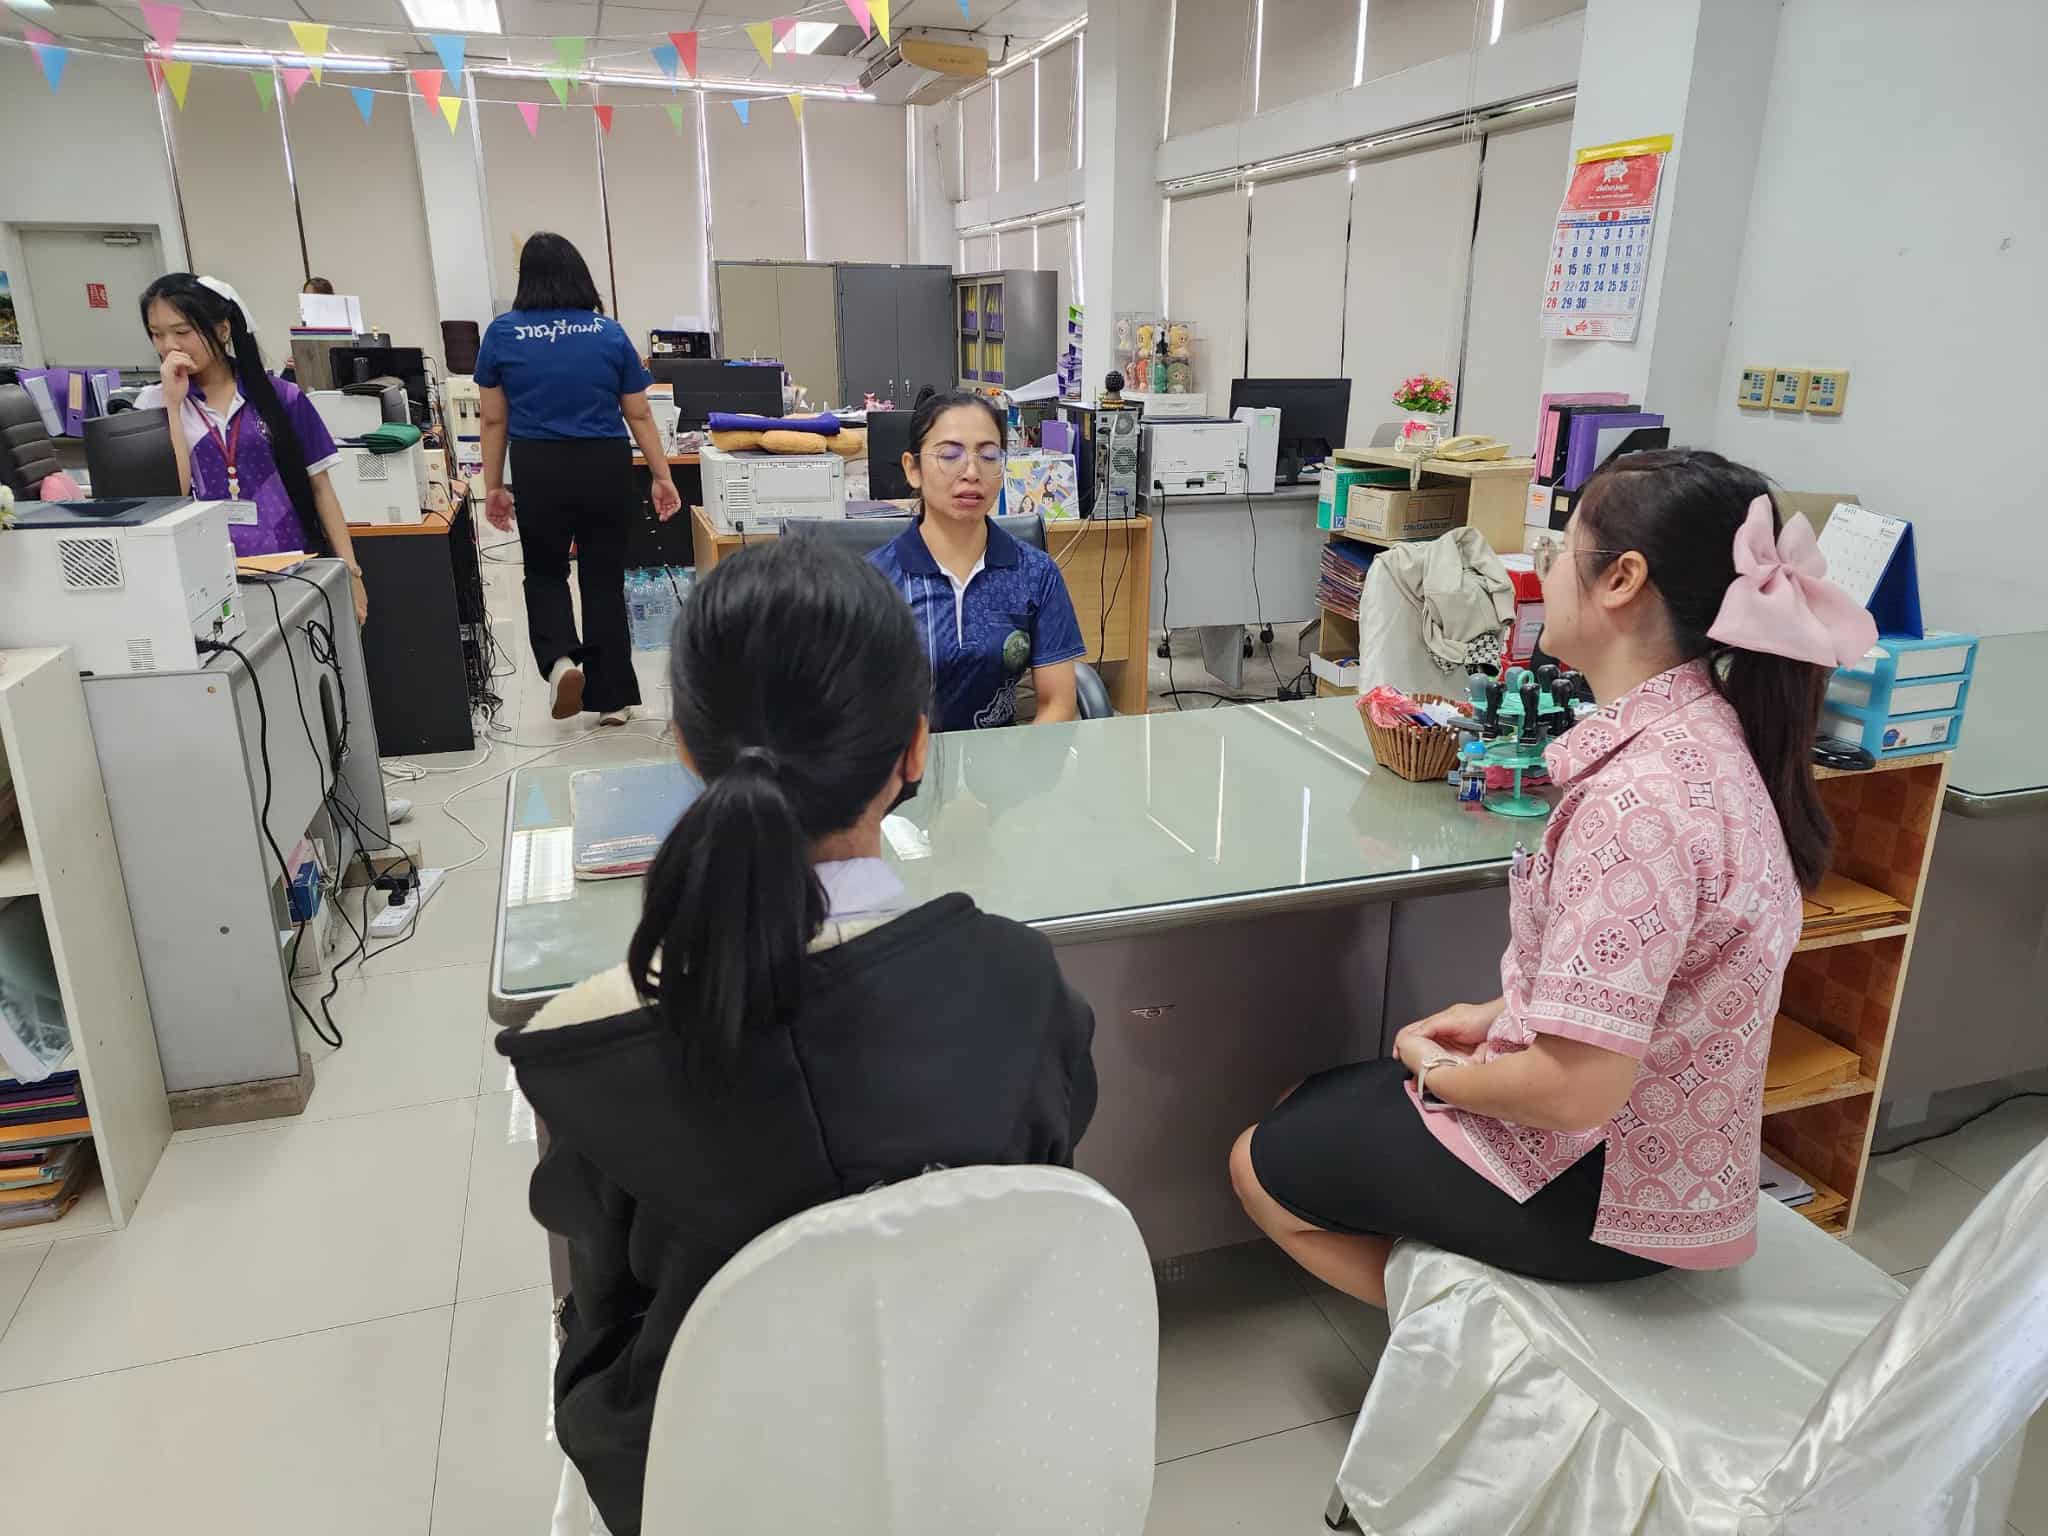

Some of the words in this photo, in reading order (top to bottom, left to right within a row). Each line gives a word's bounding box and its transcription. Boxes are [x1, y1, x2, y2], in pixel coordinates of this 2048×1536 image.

[1604, 227, 1610, 240] 3
[1572, 246, 1578, 258] 8
[1586, 246, 1592, 257] 9
[1600, 246, 1609, 257] 10
[1553, 264, 1562, 274] 14
[1568, 264, 1577, 275] 15
[1583, 263, 1592, 275] 16
[1598, 263, 1606, 275] 17
[1550, 280, 1560, 291] 21
[1580, 280, 1589, 292] 23
[1594, 280, 1604, 292] 24
[1608, 280, 1616, 292] 25
[1619, 280, 1628, 292] 26
[1546, 296, 1557, 308] 28
[1561, 297, 1572, 309] 29
[1576, 297, 1587, 309] 30
